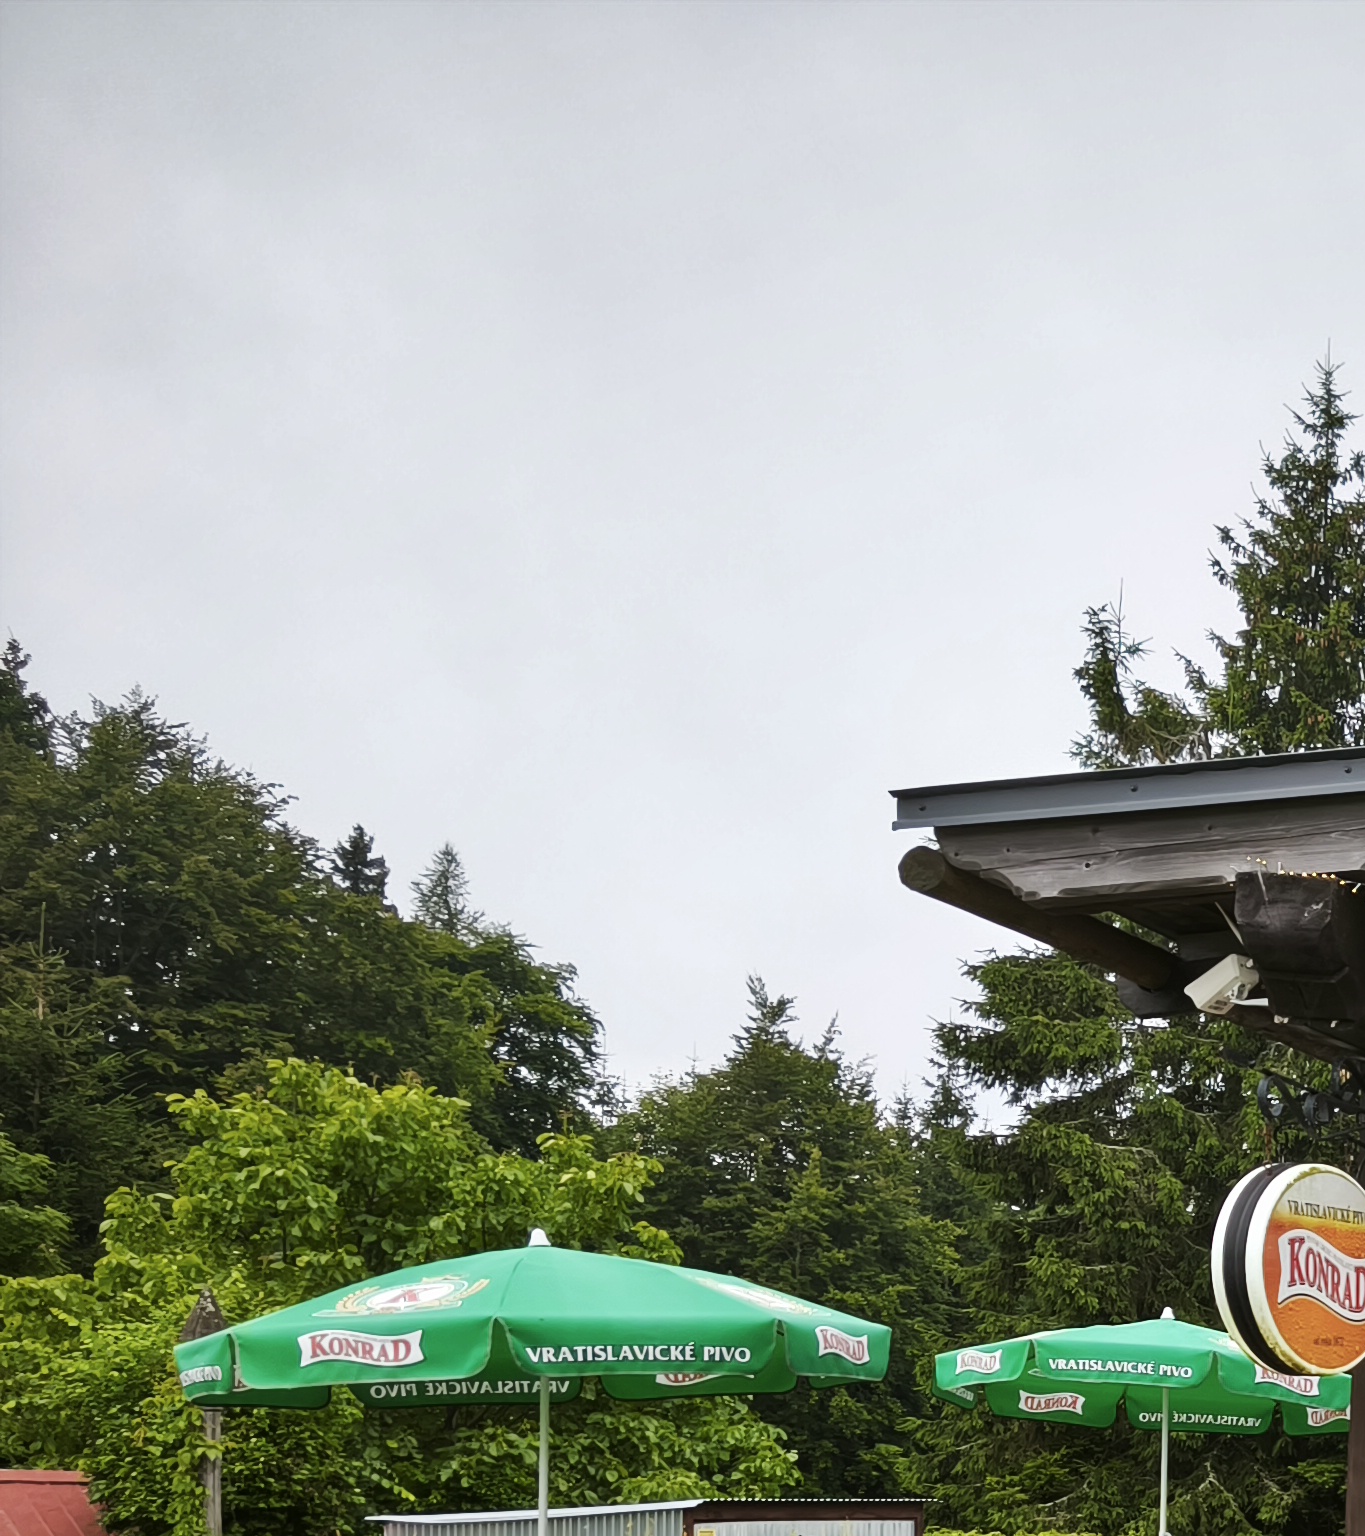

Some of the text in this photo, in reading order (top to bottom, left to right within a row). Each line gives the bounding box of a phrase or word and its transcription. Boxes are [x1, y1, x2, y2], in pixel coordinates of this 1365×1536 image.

[309, 1333, 412, 1362] KONRAD
[525, 1341, 752, 1363] VRATISLAVICKÉ PIVO
[822, 1328, 867, 1362] KONRAD
[1048, 1358, 1193, 1378] VRATISLAVICKÉ PIVO
